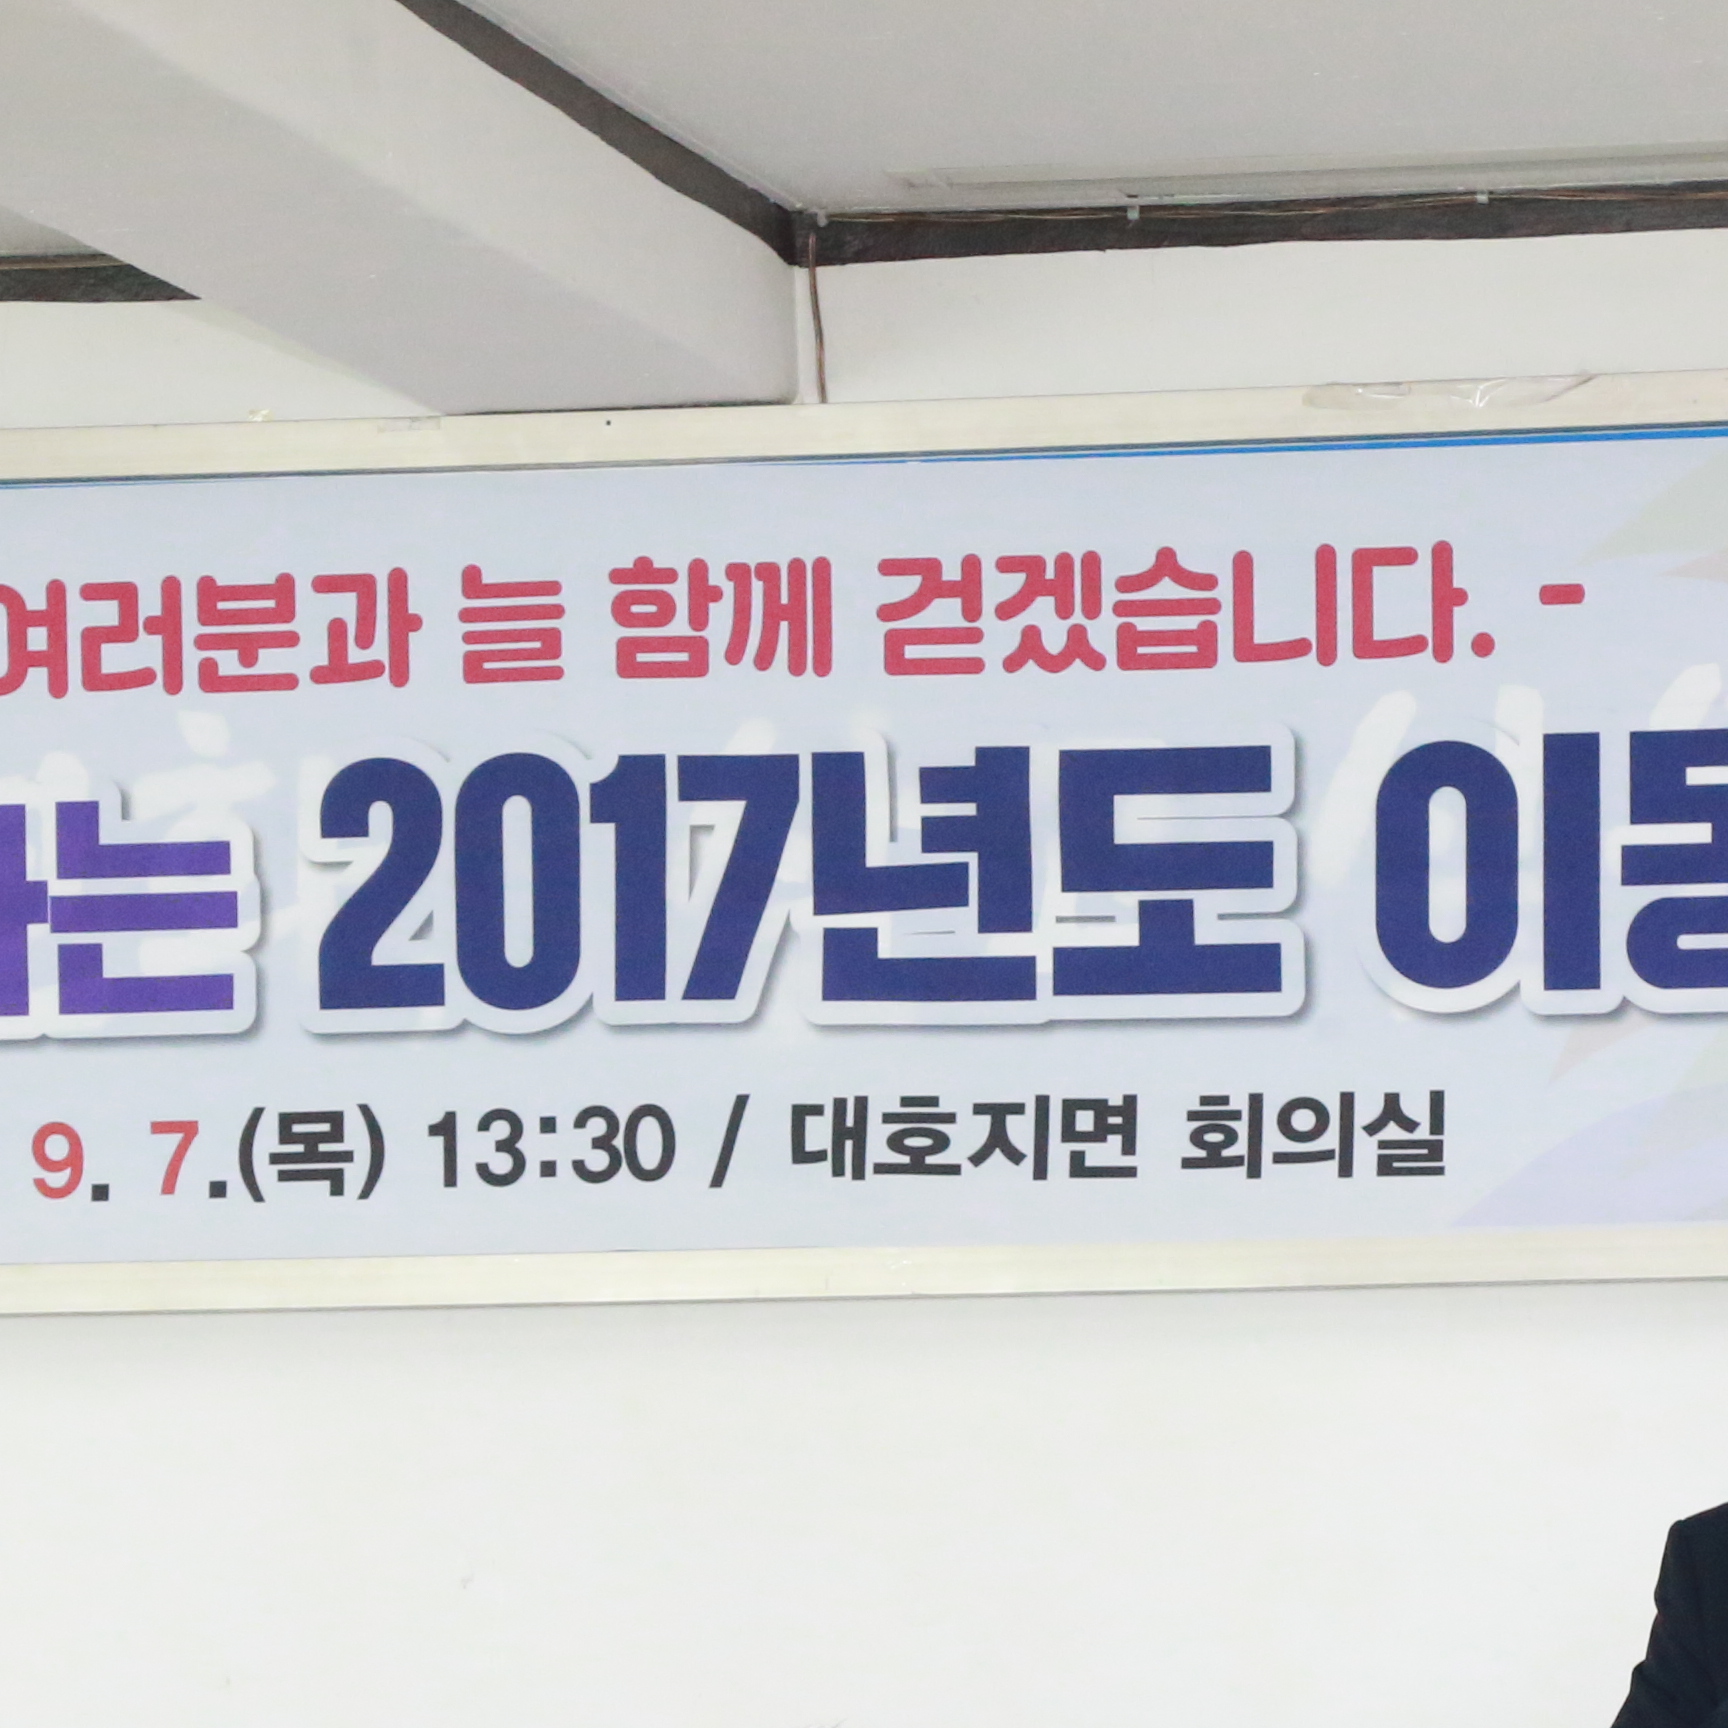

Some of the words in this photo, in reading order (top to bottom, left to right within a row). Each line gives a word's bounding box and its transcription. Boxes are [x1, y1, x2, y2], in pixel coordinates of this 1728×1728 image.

[459, 564, 566, 686] 늘
[609, 556, 834, 679] 함께
[877, 541, 1496, 676] 걷겠습니다.
[319, 746, 1283, 1012] 2017년도
[32, 1121, 111, 1203] 9.
[427, 1104, 678, 1190] 13:30
[709, 1093, 751, 1190] /
[790, 1093, 1139, 1183] 대호지면
[1181, 1089, 1448, 1181] 회의실
